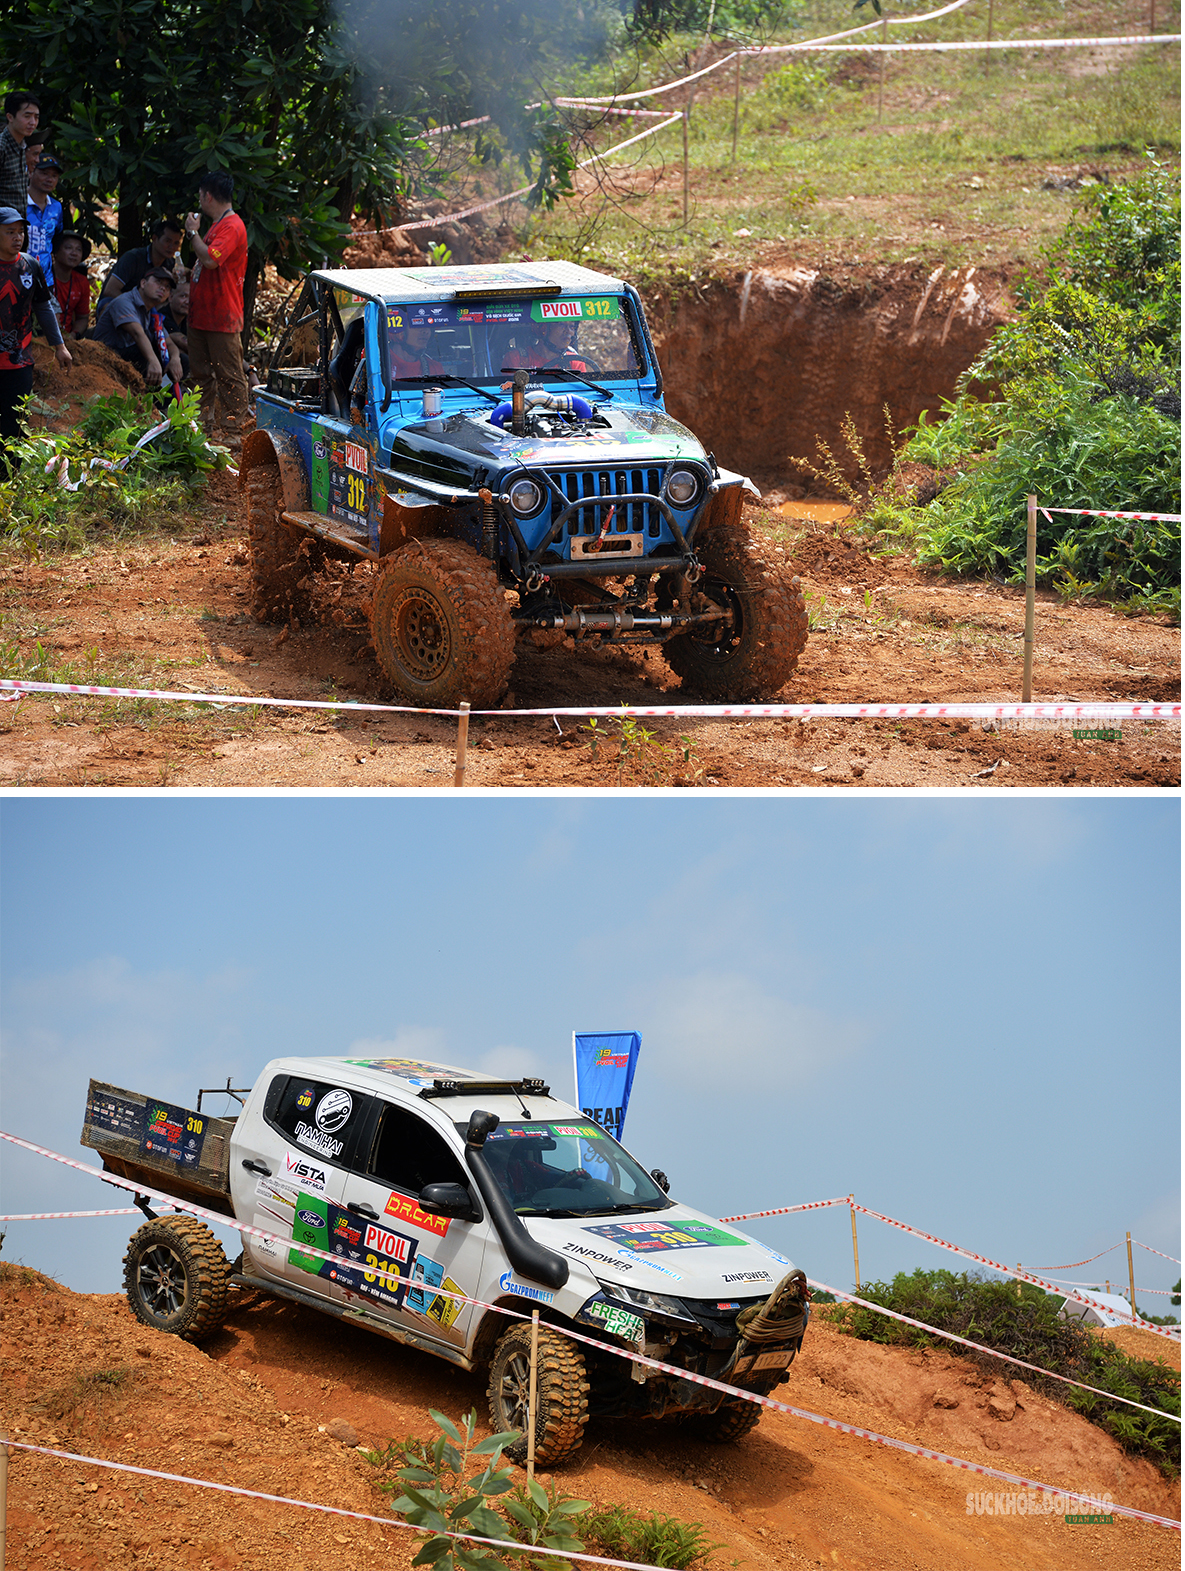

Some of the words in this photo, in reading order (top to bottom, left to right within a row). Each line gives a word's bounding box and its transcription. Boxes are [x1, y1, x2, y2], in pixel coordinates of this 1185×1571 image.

[32, 225, 40, 253] CUP
[541, 302, 580, 317] PVOIL
[585, 300, 611, 316] 312
[346, 445, 367, 473] PVOIL
[348, 473, 365, 512] 312
[599, 1048, 612, 1057] 19
[297, 1095, 312, 1107] 310
[155, 1110, 168, 1122] 19
[186, 1116, 203, 1135] 310
[294, 1120, 344, 1156] NAMHAI
[302, 1211, 321, 1227] Ford
[387, 1196, 447, 1231] DR.CAR
[338, 1217, 349, 1227] 19
[620, 1222, 671, 1233] PVOIL
[366, 1226, 406, 1261] PVOIL
[649, 1231, 698, 1244] 310
[562, 1242, 633, 1272] ZINPOWER
[363, 1253, 401, 1293] 310
[721, 1270, 771, 1283] ZINPOWER
[509, 1283, 554, 1303] GAZPROMNEFT
[717, 1302, 740, 1310] AMSOIL
